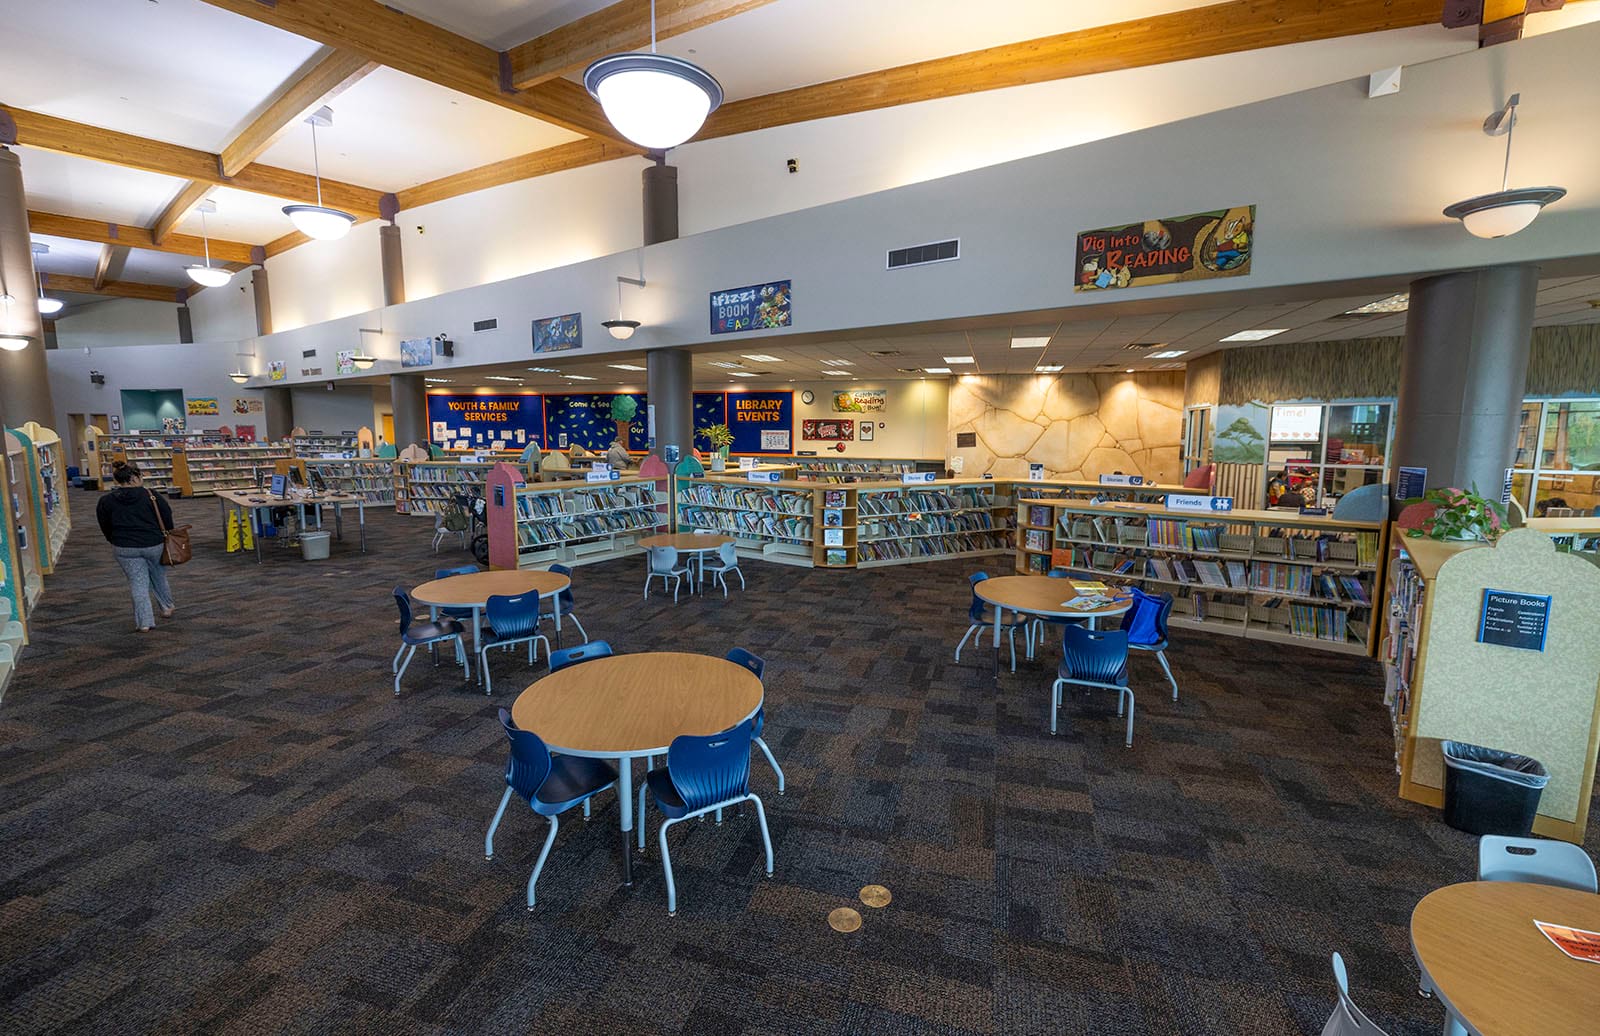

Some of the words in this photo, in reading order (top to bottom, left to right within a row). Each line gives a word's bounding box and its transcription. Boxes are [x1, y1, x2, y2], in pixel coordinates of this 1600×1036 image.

[1083, 236, 1105, 252] Dig
[1110, 235, 1140, 248] Into
[1106, 246, 1191, 270] READING
[719, 303, 750, 319] BOOM
[719, 317, 750, 331] READ
[448, 401, 478, 411] YOUTH
[479, 401, 487, 411] &
[488, 401, 520, 411] FAMILY
[736, 399, 783, 410] LIBRARY
[854, 397, 884, 405] Reading
[464, 412, 508, 421] SERVICES
[737, 411, 780, 421] EVENTS
[1490, 595, 1518, 605] Picture
[1519, 598, 1546, 608] Books
